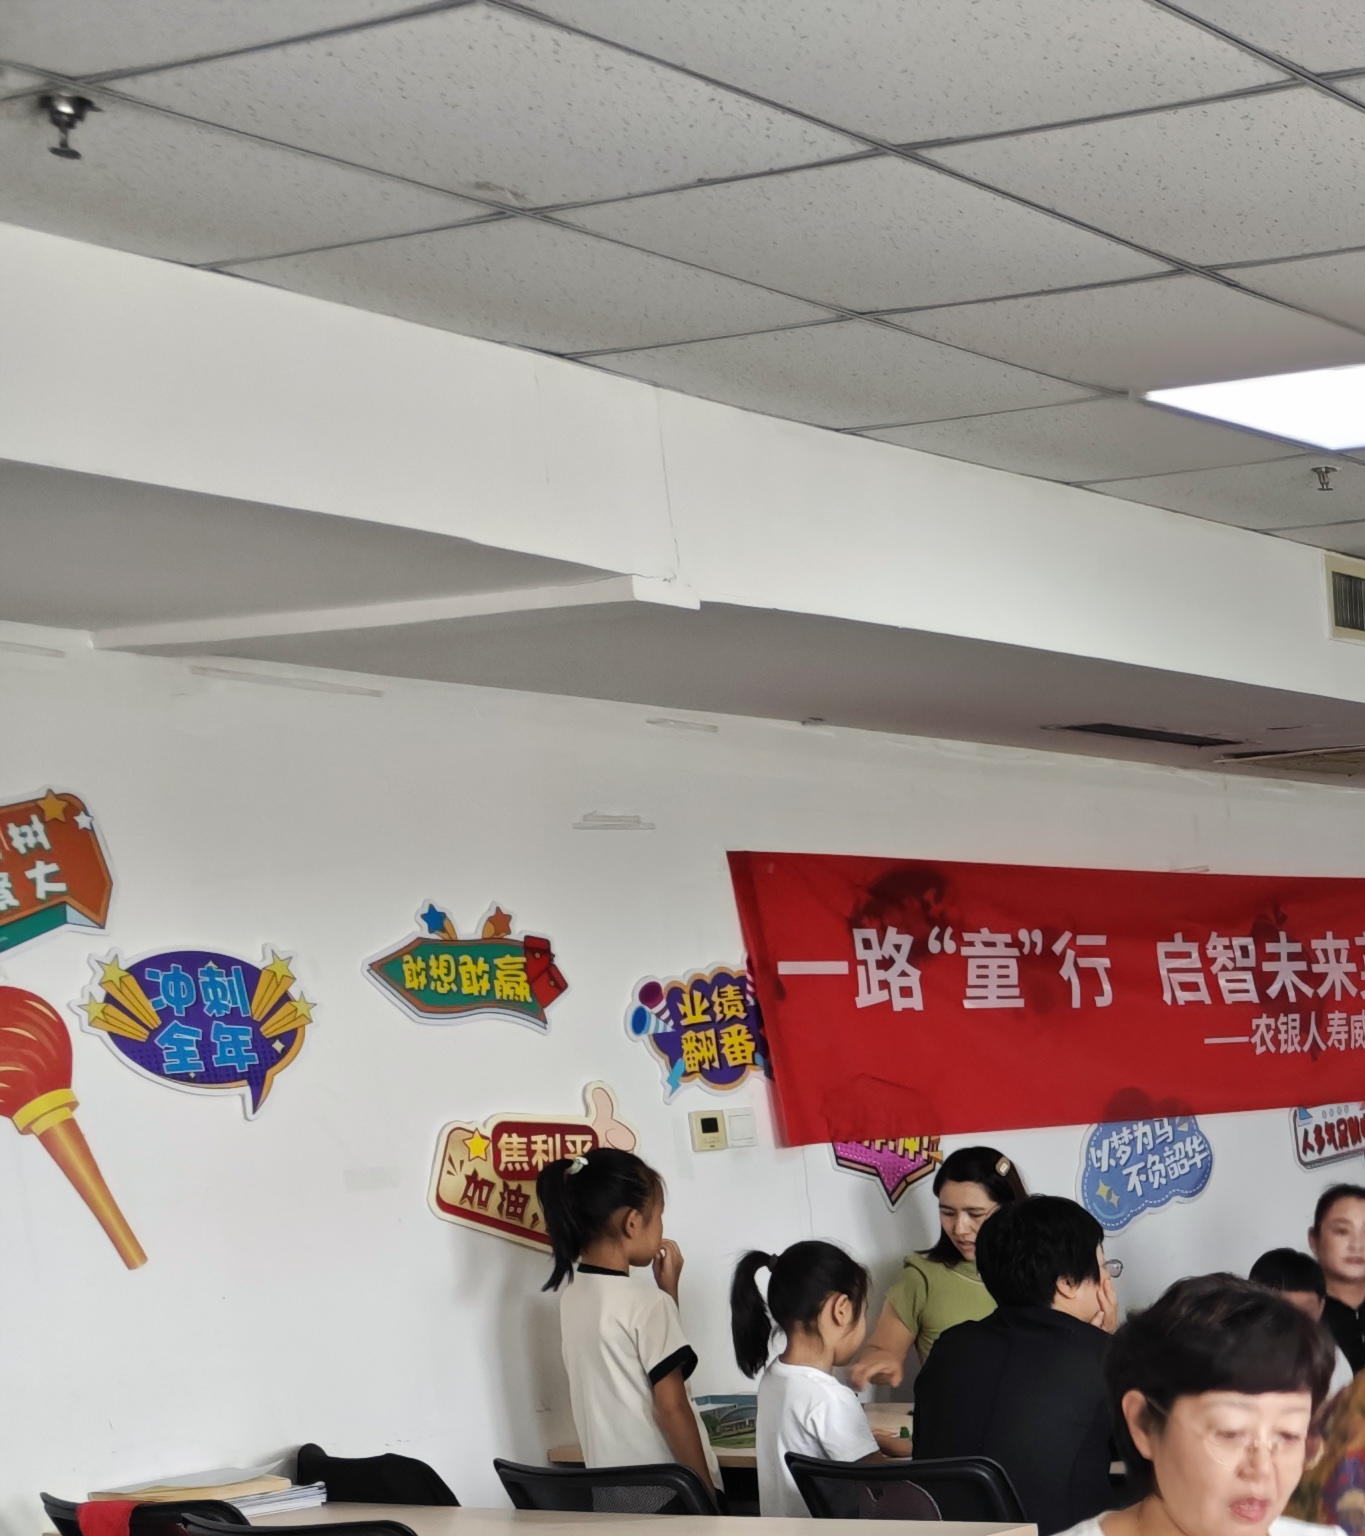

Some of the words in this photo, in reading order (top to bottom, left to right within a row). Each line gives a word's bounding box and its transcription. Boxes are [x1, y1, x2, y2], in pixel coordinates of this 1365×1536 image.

[144, 964, 252, 1017] 冲刺
[402, 953, 533, 1003] 敢想敢赢
[678, 980, 746, 1028] 业绩
[155, 1023, 260, 1074] 全年
[680, 1025, 758, 1073] 翻番
[1090, 1118, 1173, 1172] 以梦为马
[1122, 1135, 1210, 1196] 不负韶华
